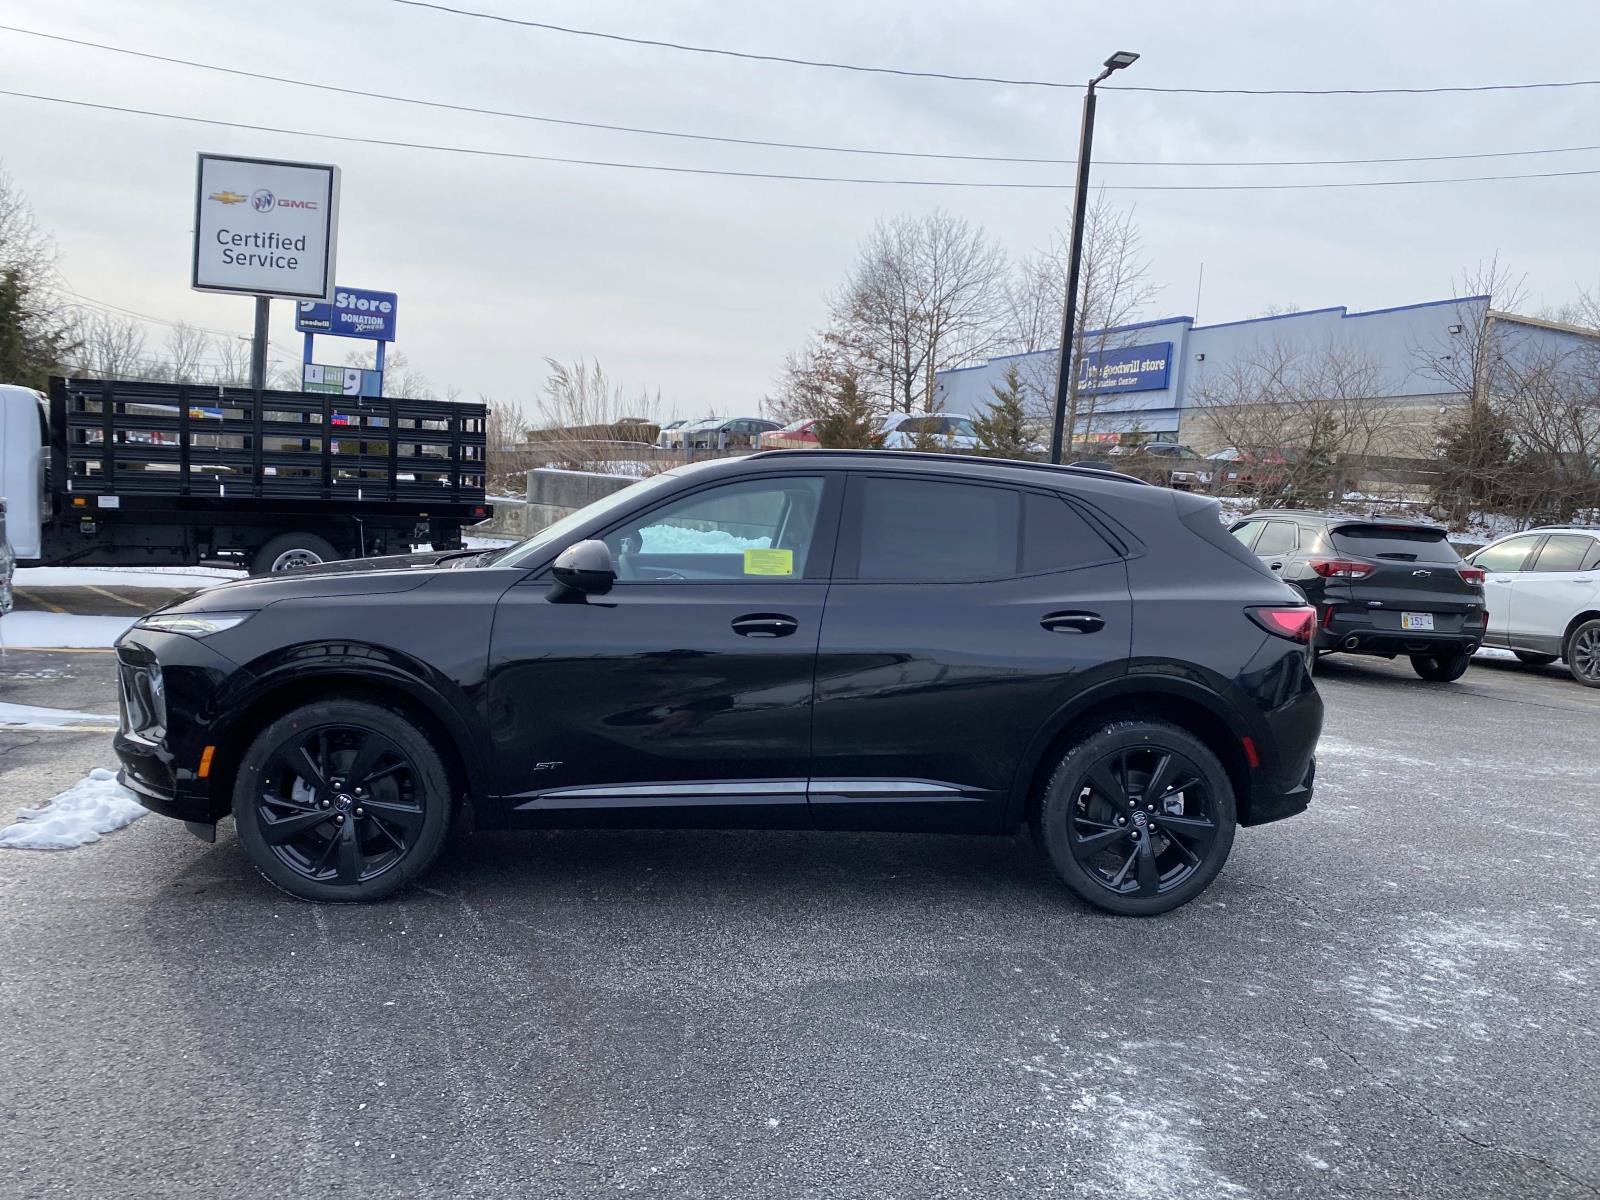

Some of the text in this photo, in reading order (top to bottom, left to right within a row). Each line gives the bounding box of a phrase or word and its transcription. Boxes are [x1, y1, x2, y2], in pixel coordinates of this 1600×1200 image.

[277, 199, 318, 210] GMC
[216, 228, 306, 252] Certified
[222, 248, 298, 270] Service
[335, 292, 392, 313] Store
[340, 313, 384, 326] DONATION
[1102, 360, 1140, 378] goodwill
[1141, 359, 1166, 372] store
[1409, 615, 1424, 626] 151
